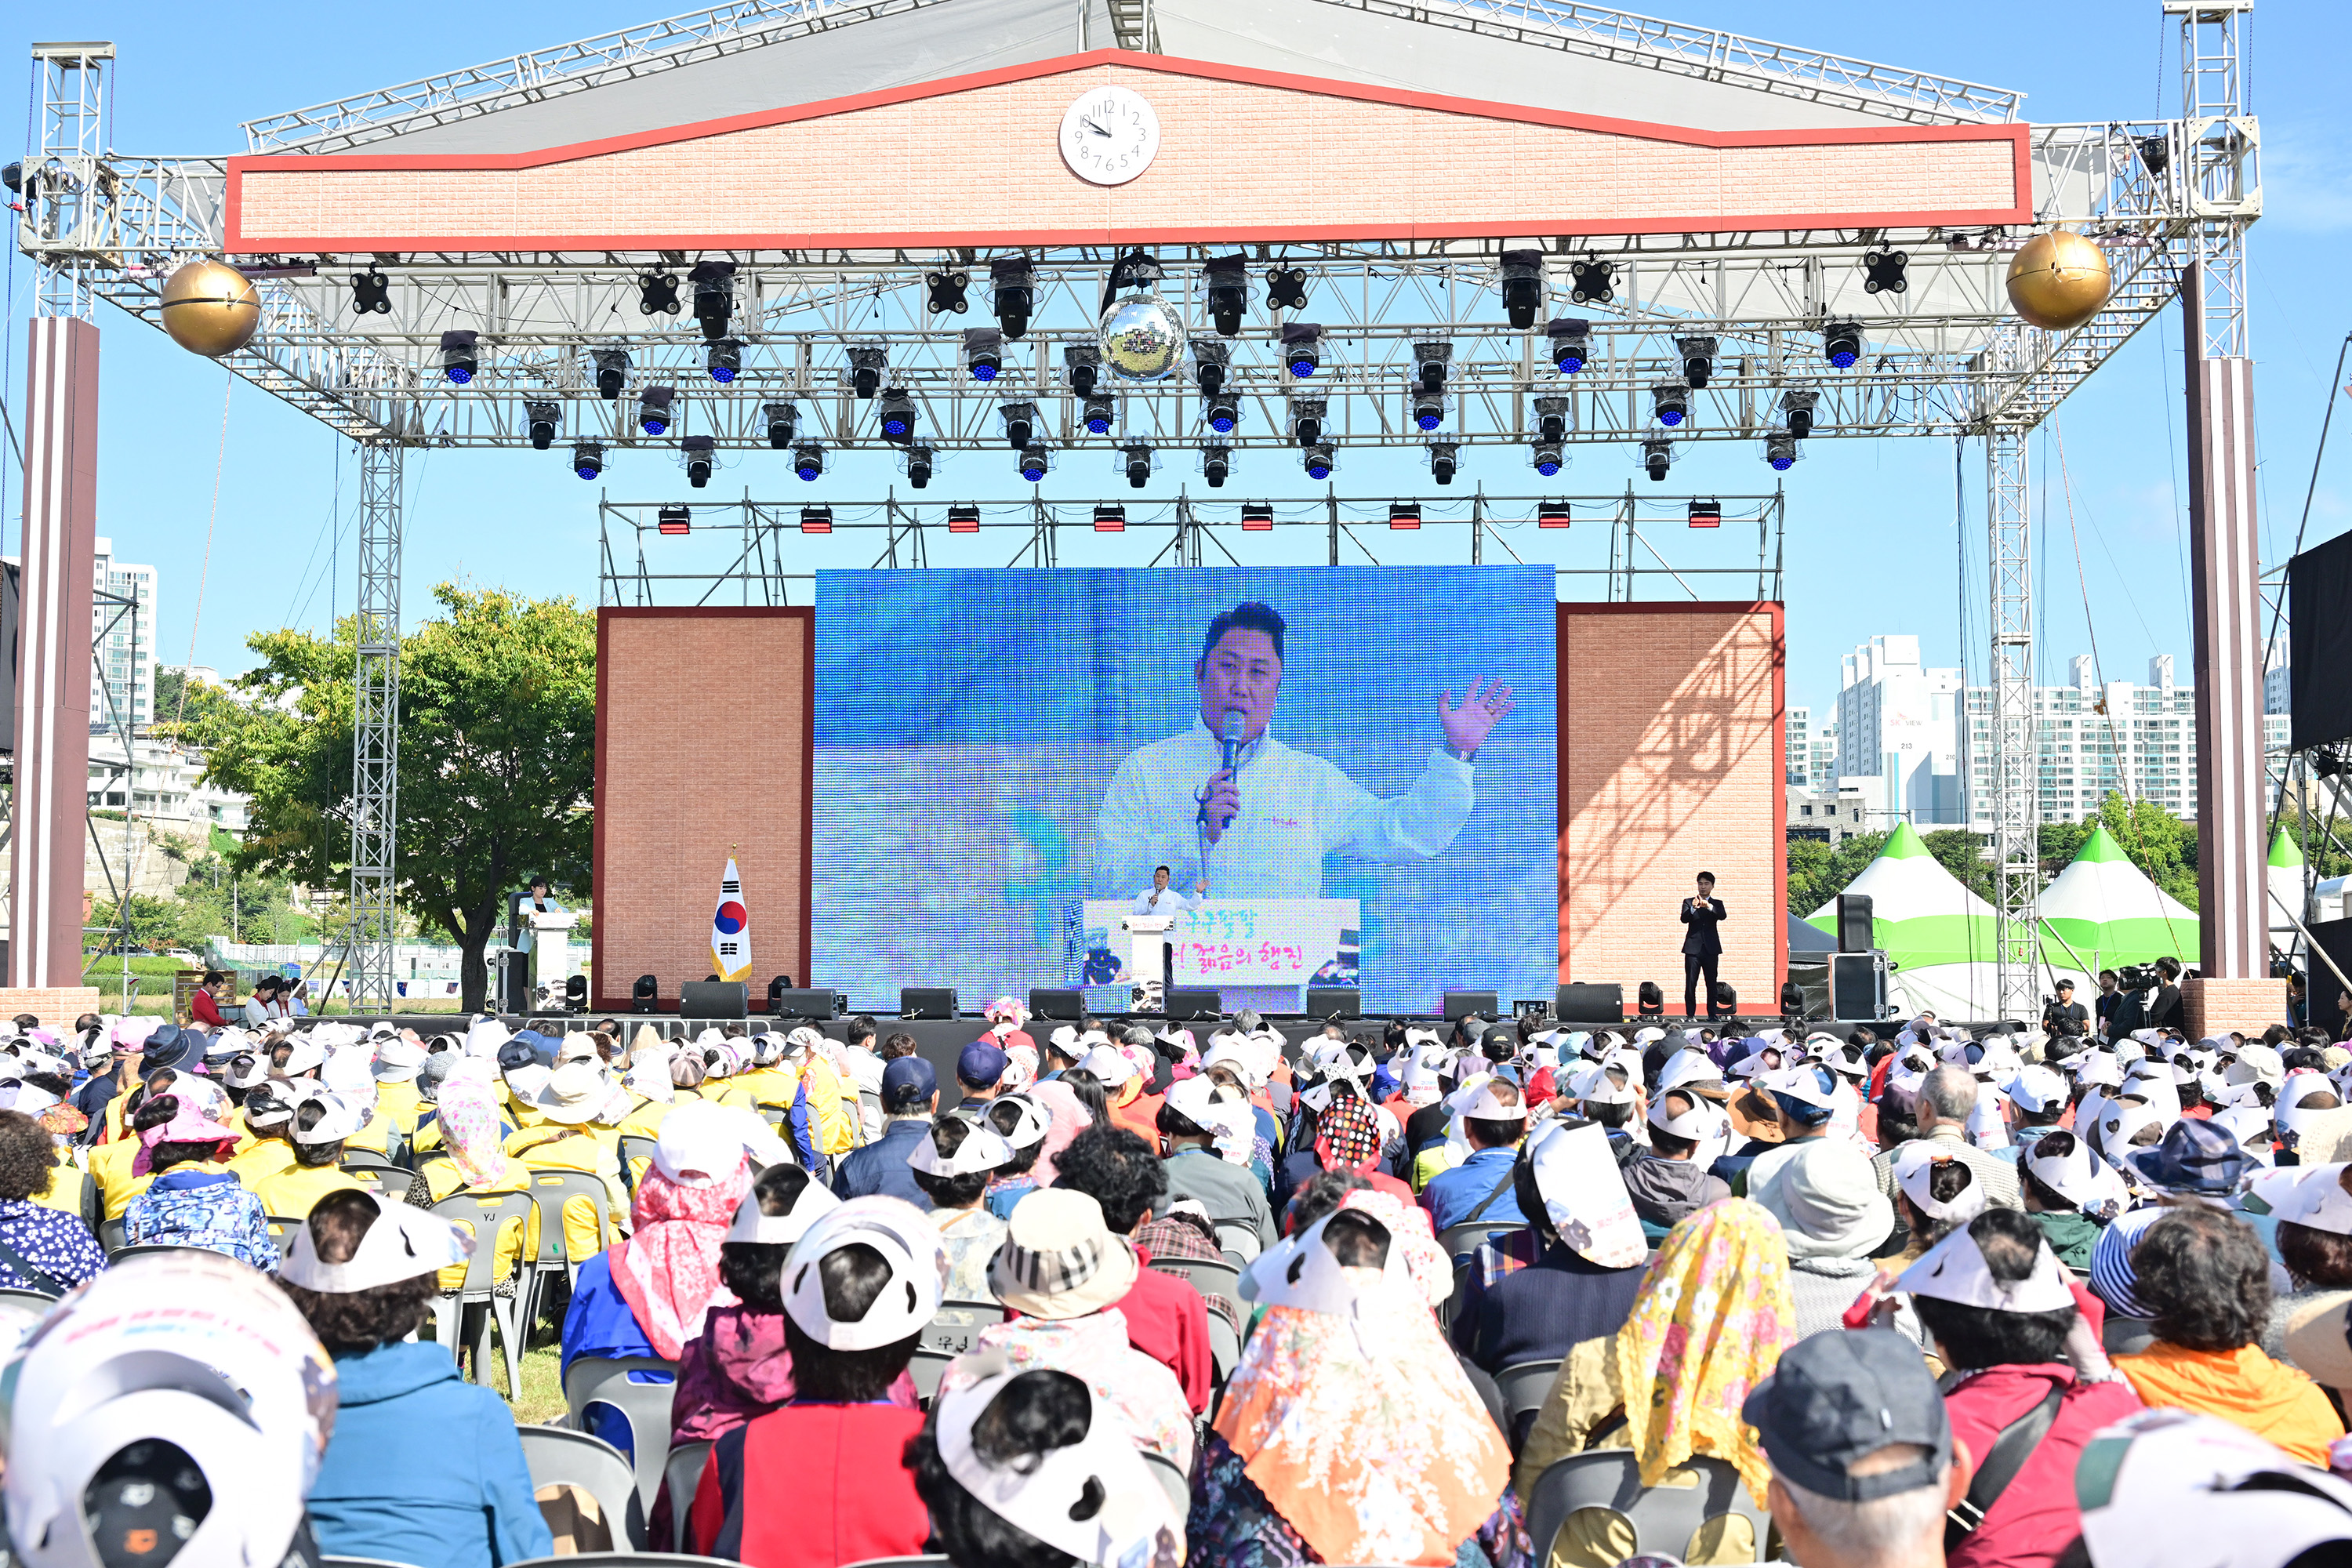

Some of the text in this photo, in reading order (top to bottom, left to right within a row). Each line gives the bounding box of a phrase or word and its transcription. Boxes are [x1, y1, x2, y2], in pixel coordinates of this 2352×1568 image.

[1092, 104, 1101, 118] 11
[1104, 100, 1115, 114] 12
[1080, 114, 1091, 128] 10
[1131, 111, 1140, 125] 2
[1074, 131, 1083, 144] 9
[1138, 128, 1146, 142] 3
[1080, 146, 1089, 159] 8
[1131, 144, 1141, 158] 4
[1093, 155, 1102, 168] 7
[1105, 158, 1114, 171] 6
[1120, 154, 1128, 168] 5
[1192, 942, 1252, 974] 젊음의
[1258, 940, 1304, 971] 행진
[483, 1212, 495, 1222] YJ
